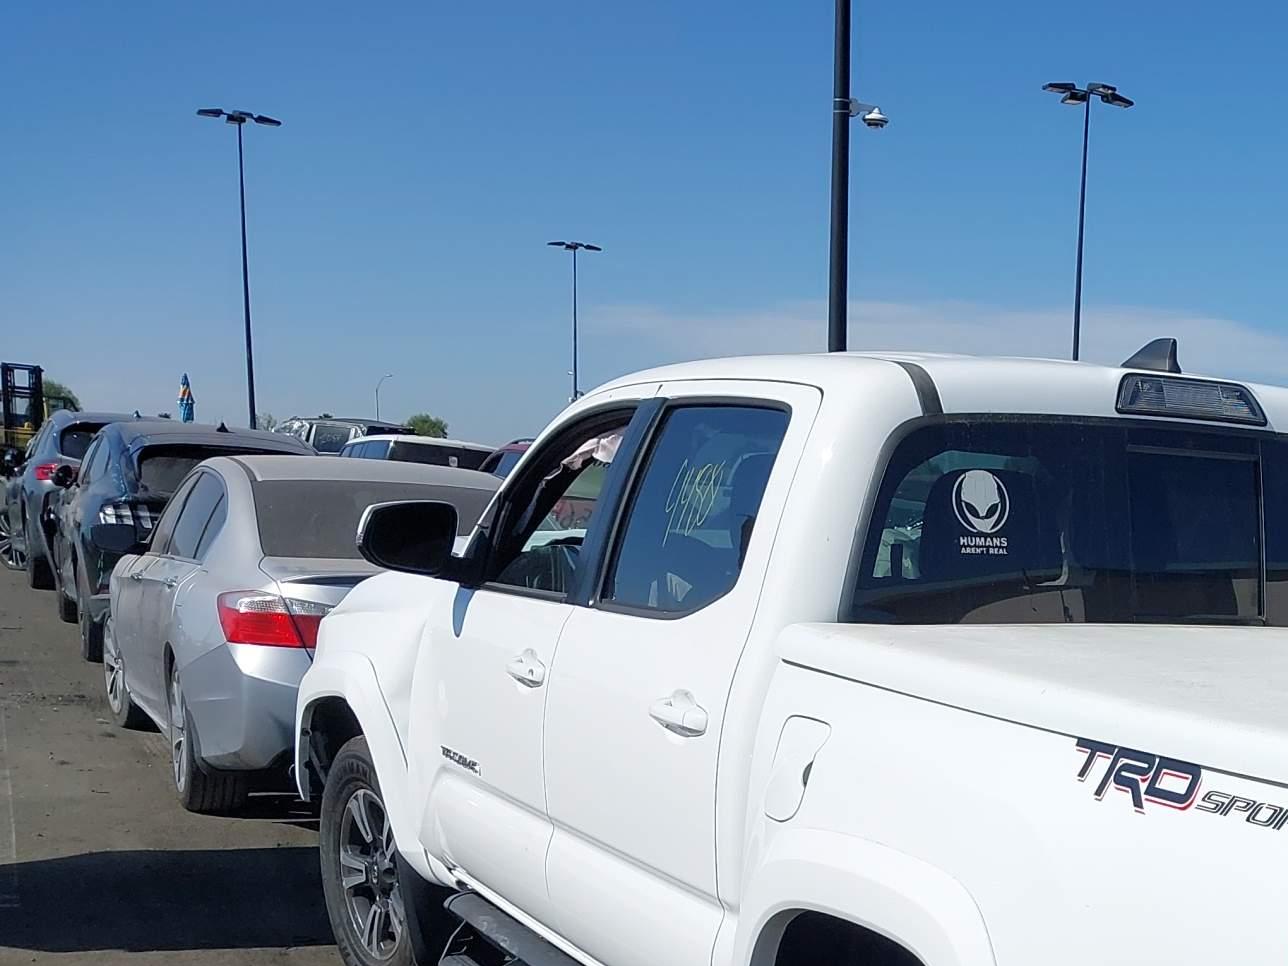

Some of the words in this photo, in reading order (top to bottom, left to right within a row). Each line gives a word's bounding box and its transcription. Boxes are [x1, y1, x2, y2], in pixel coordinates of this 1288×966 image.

[959, 536, 1008, 547] HUMANS
[960, 546, 986, 554] AREN'T
[989, 547, 1008, 555] REAL
[1075, 737, 1202, 815] TRD
